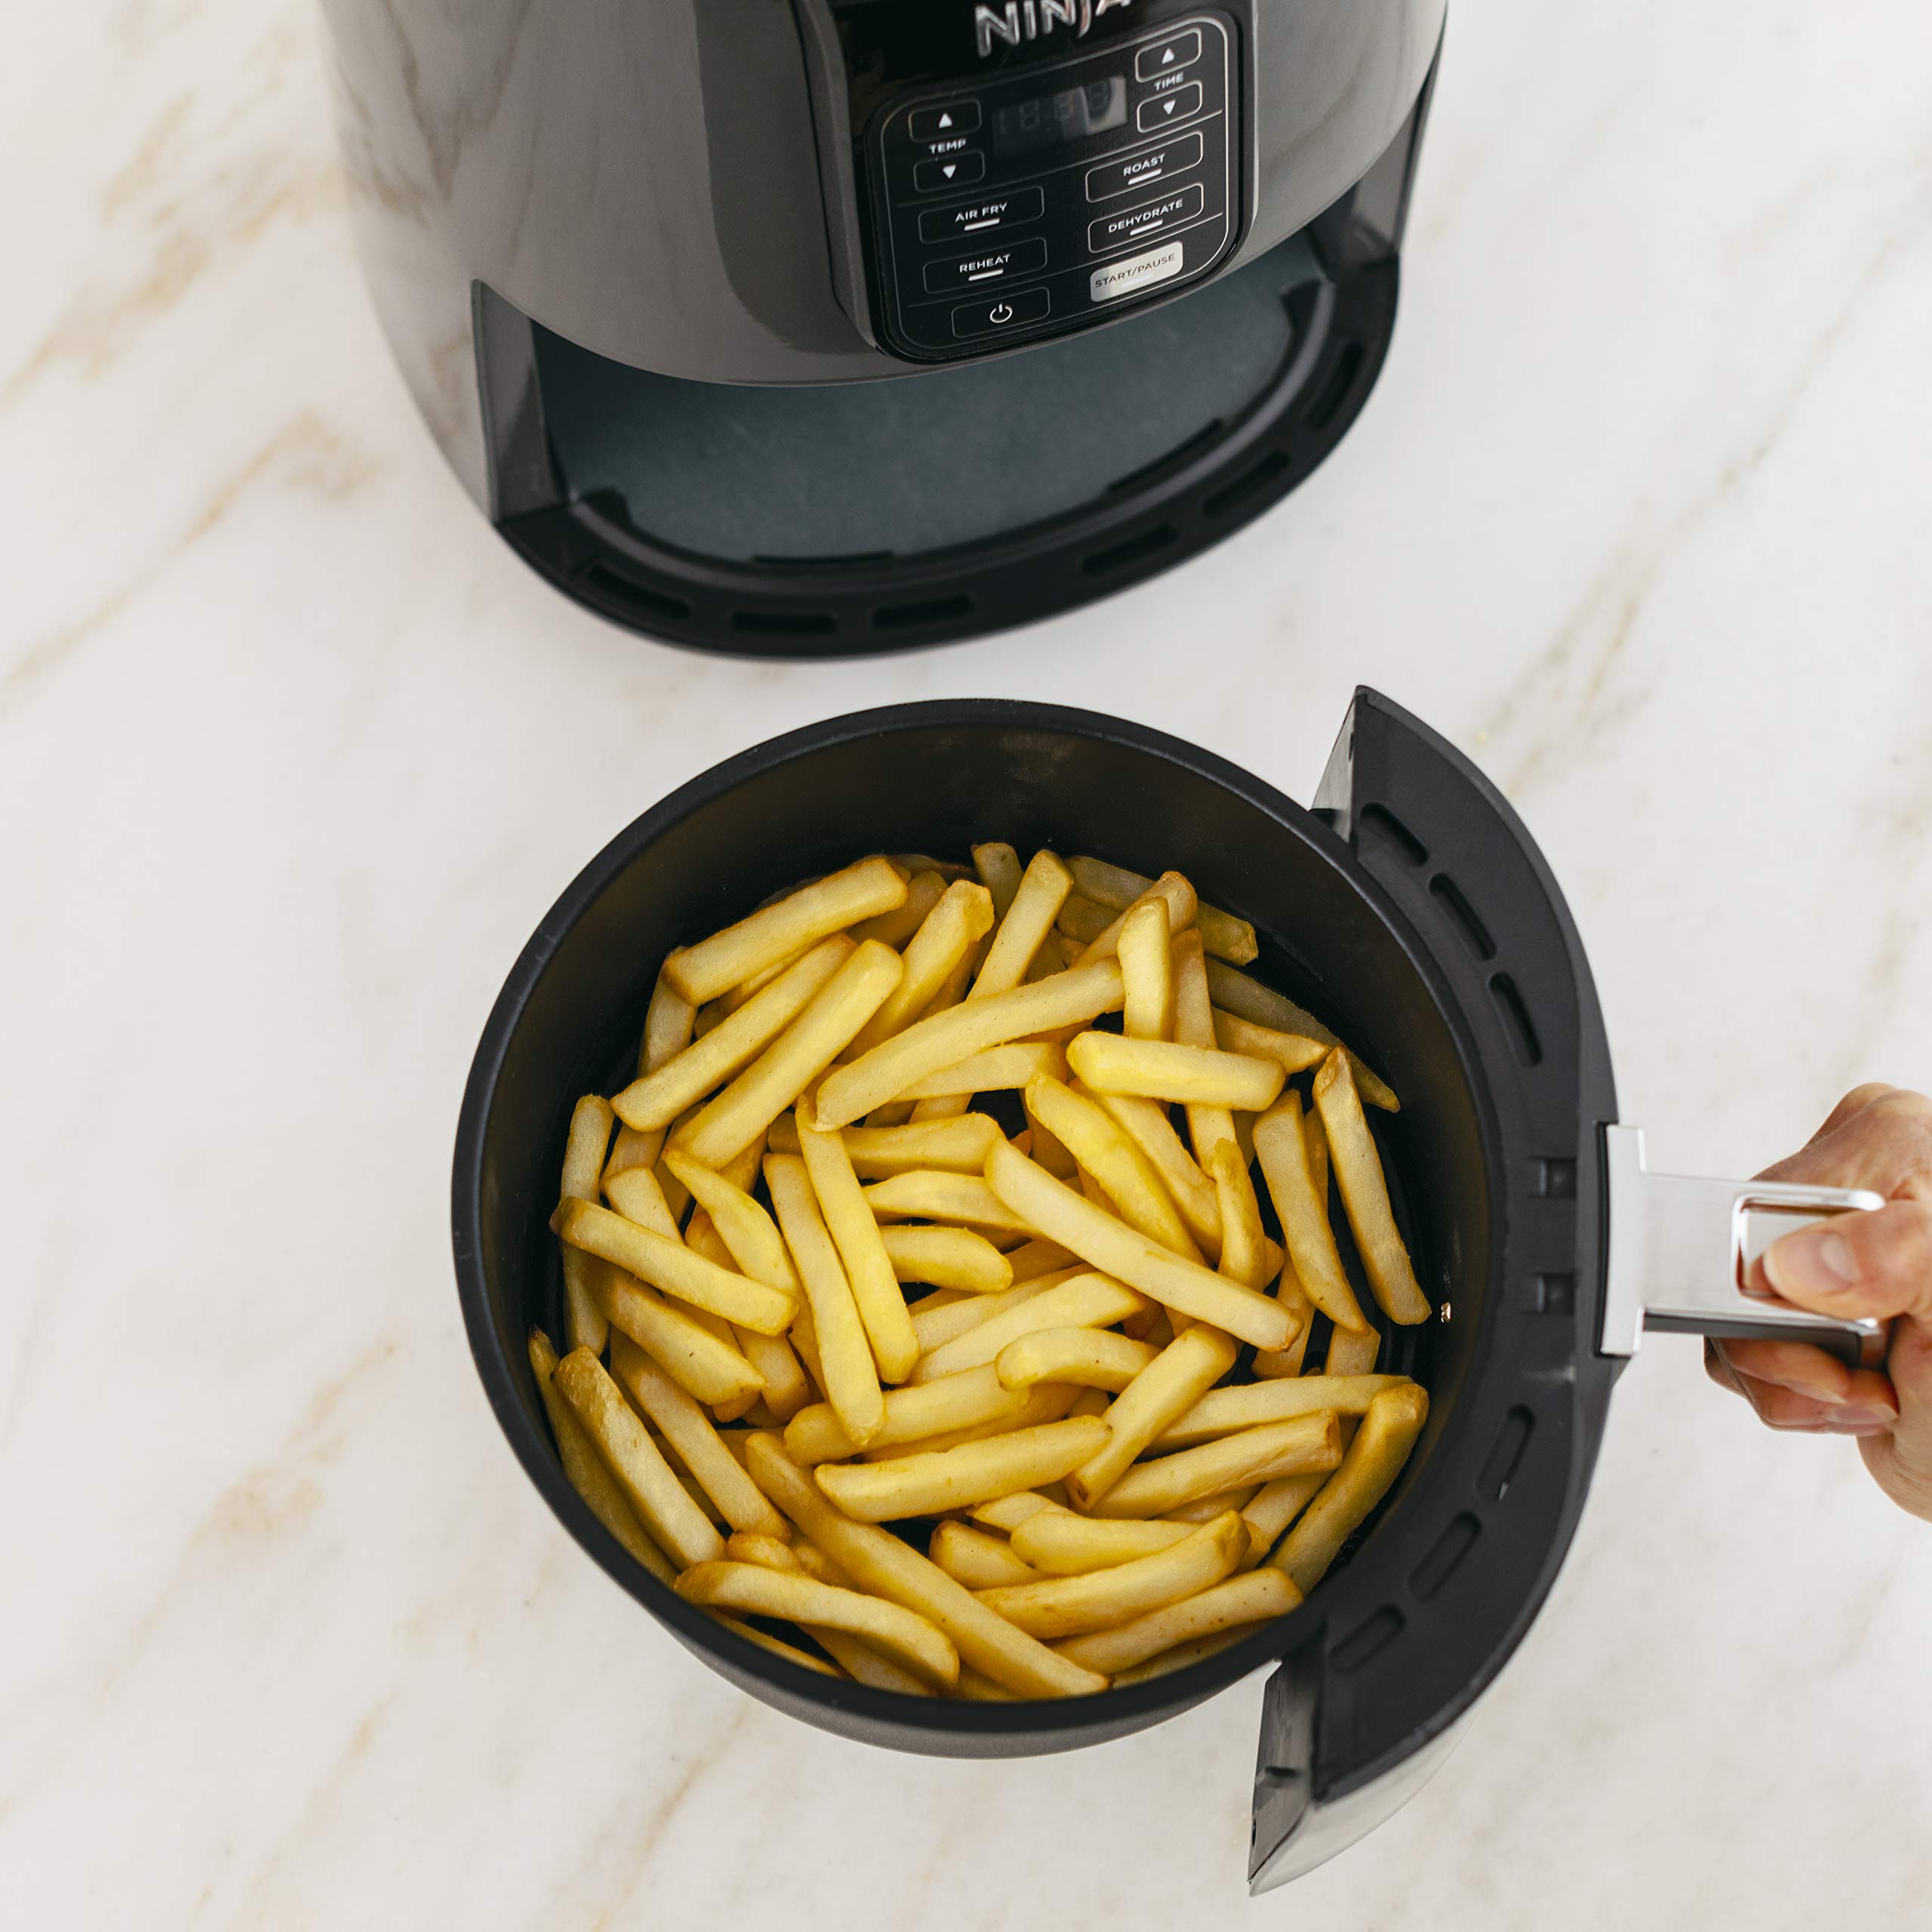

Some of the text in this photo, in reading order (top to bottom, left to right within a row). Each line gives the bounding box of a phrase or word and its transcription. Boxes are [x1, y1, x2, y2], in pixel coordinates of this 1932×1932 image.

[1154, 72, 1184, 91] TIME
[929, 139, 967, 155] TEMP
[1123, 154, 1165, 177] ROAST
[955, 202, 1008, 223] AIR FRY
[1108, 198, 1183, 233] DEHYDRATE
[959, 254, 1011, 273] REHEAT
[1094, 254, 1175, 288] START/PAUSE
